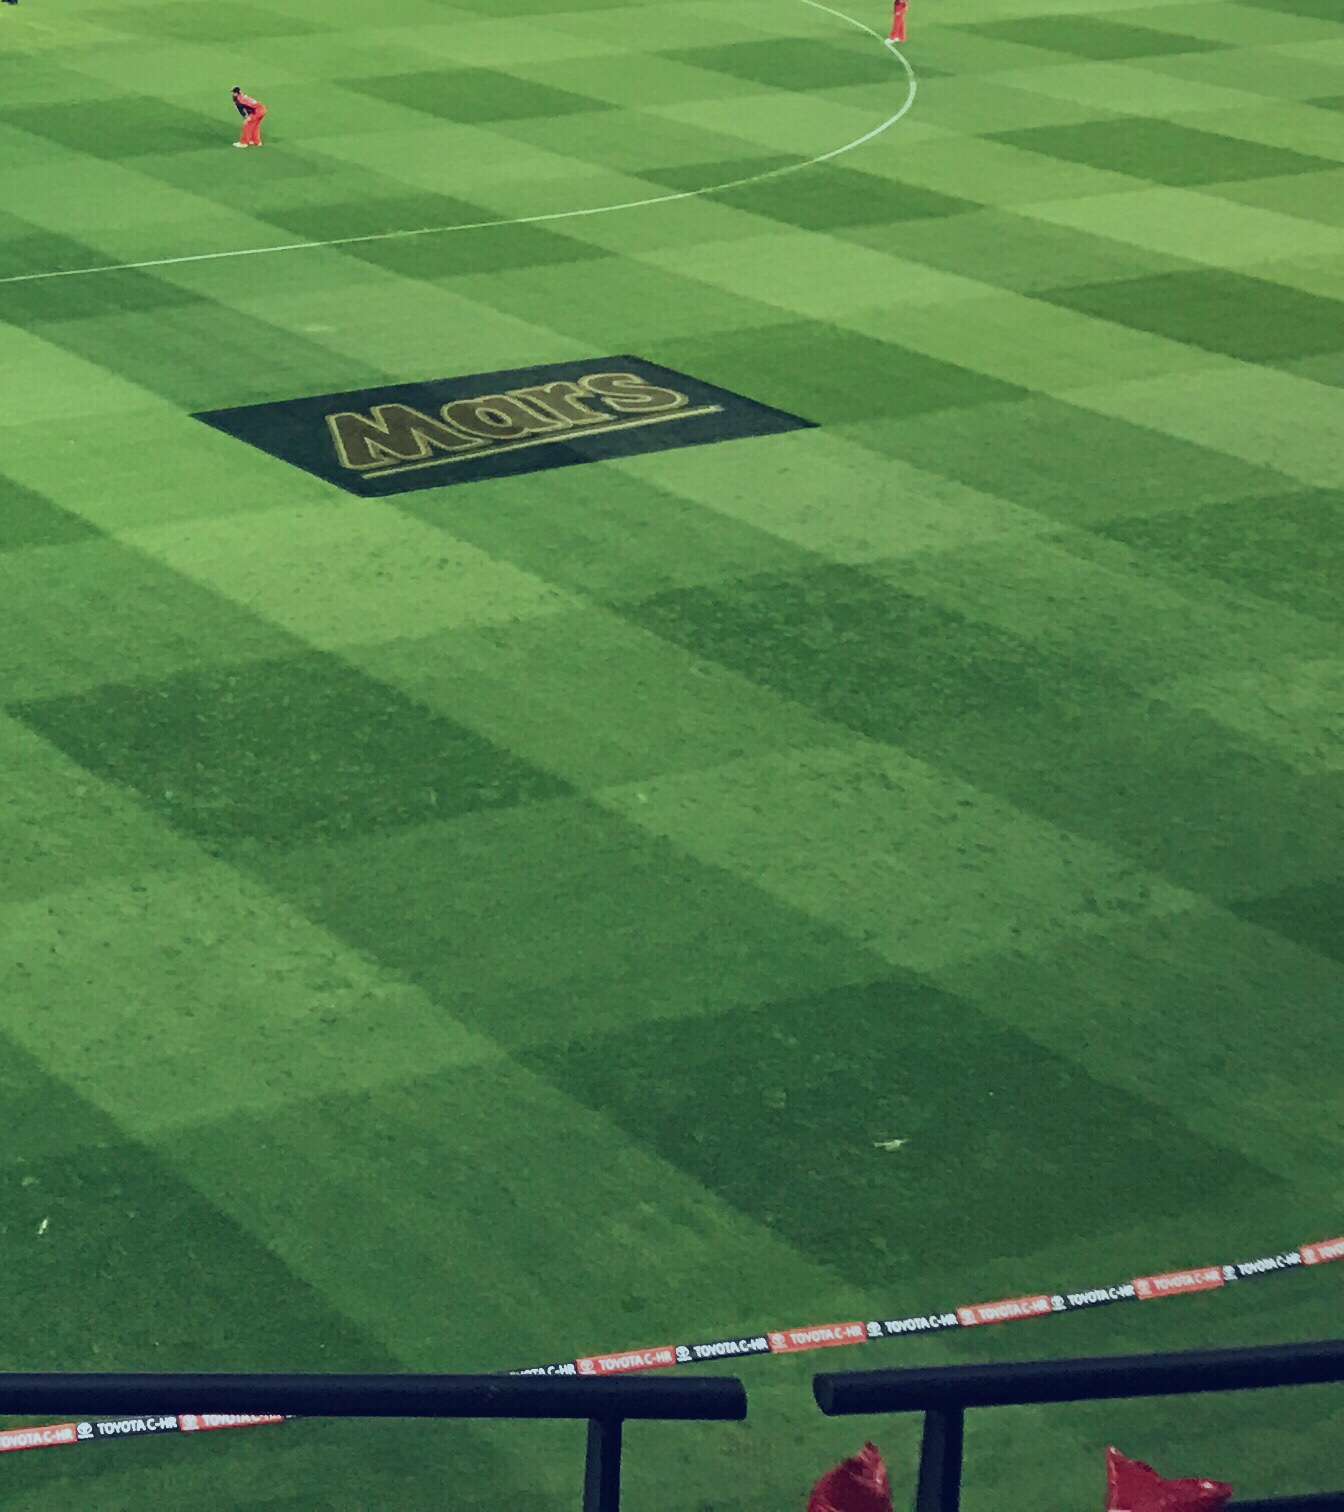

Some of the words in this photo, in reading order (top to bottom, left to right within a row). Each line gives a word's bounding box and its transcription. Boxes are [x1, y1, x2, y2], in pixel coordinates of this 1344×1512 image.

[326, 372, 690, 471] Mars
[1240, 1257, 1276, 1275] TOYOTA
[1276, 1252, 1301, 1268] C-HR
[1154, 1273, 1192, 1289] TOYOTA
[1194, 1268, 1219, 1284] C-HR
[1066, 1288, 1109, 1306] TOYOTA
[1110, 1284, 1134, 1300] C-HR
[978, 1304, 1020, 1320] TOYOTA
[1022, 1298, 1050, 1314] C-HR
[884, 1318, 929, 1334] TOYOTA
[929, 1313, 958, 1327] C-HR
[789, 1330, 834, 1346] TOYOTA
[835, 1325, 863, 1340] C-HR
[693, 1342, 740, 1357] TOYOTA
[740, 1338, 769, 1352] C-HR
[598, 1356, 644, 1371] TOYOTA
[644, 1350, 672, 1366] C-HR
[42, 1428, 74, 1442] C-HR
[96, 1421, 148, 1436] TOYOTA
[148, 1417, 177, 1432] C-HR
